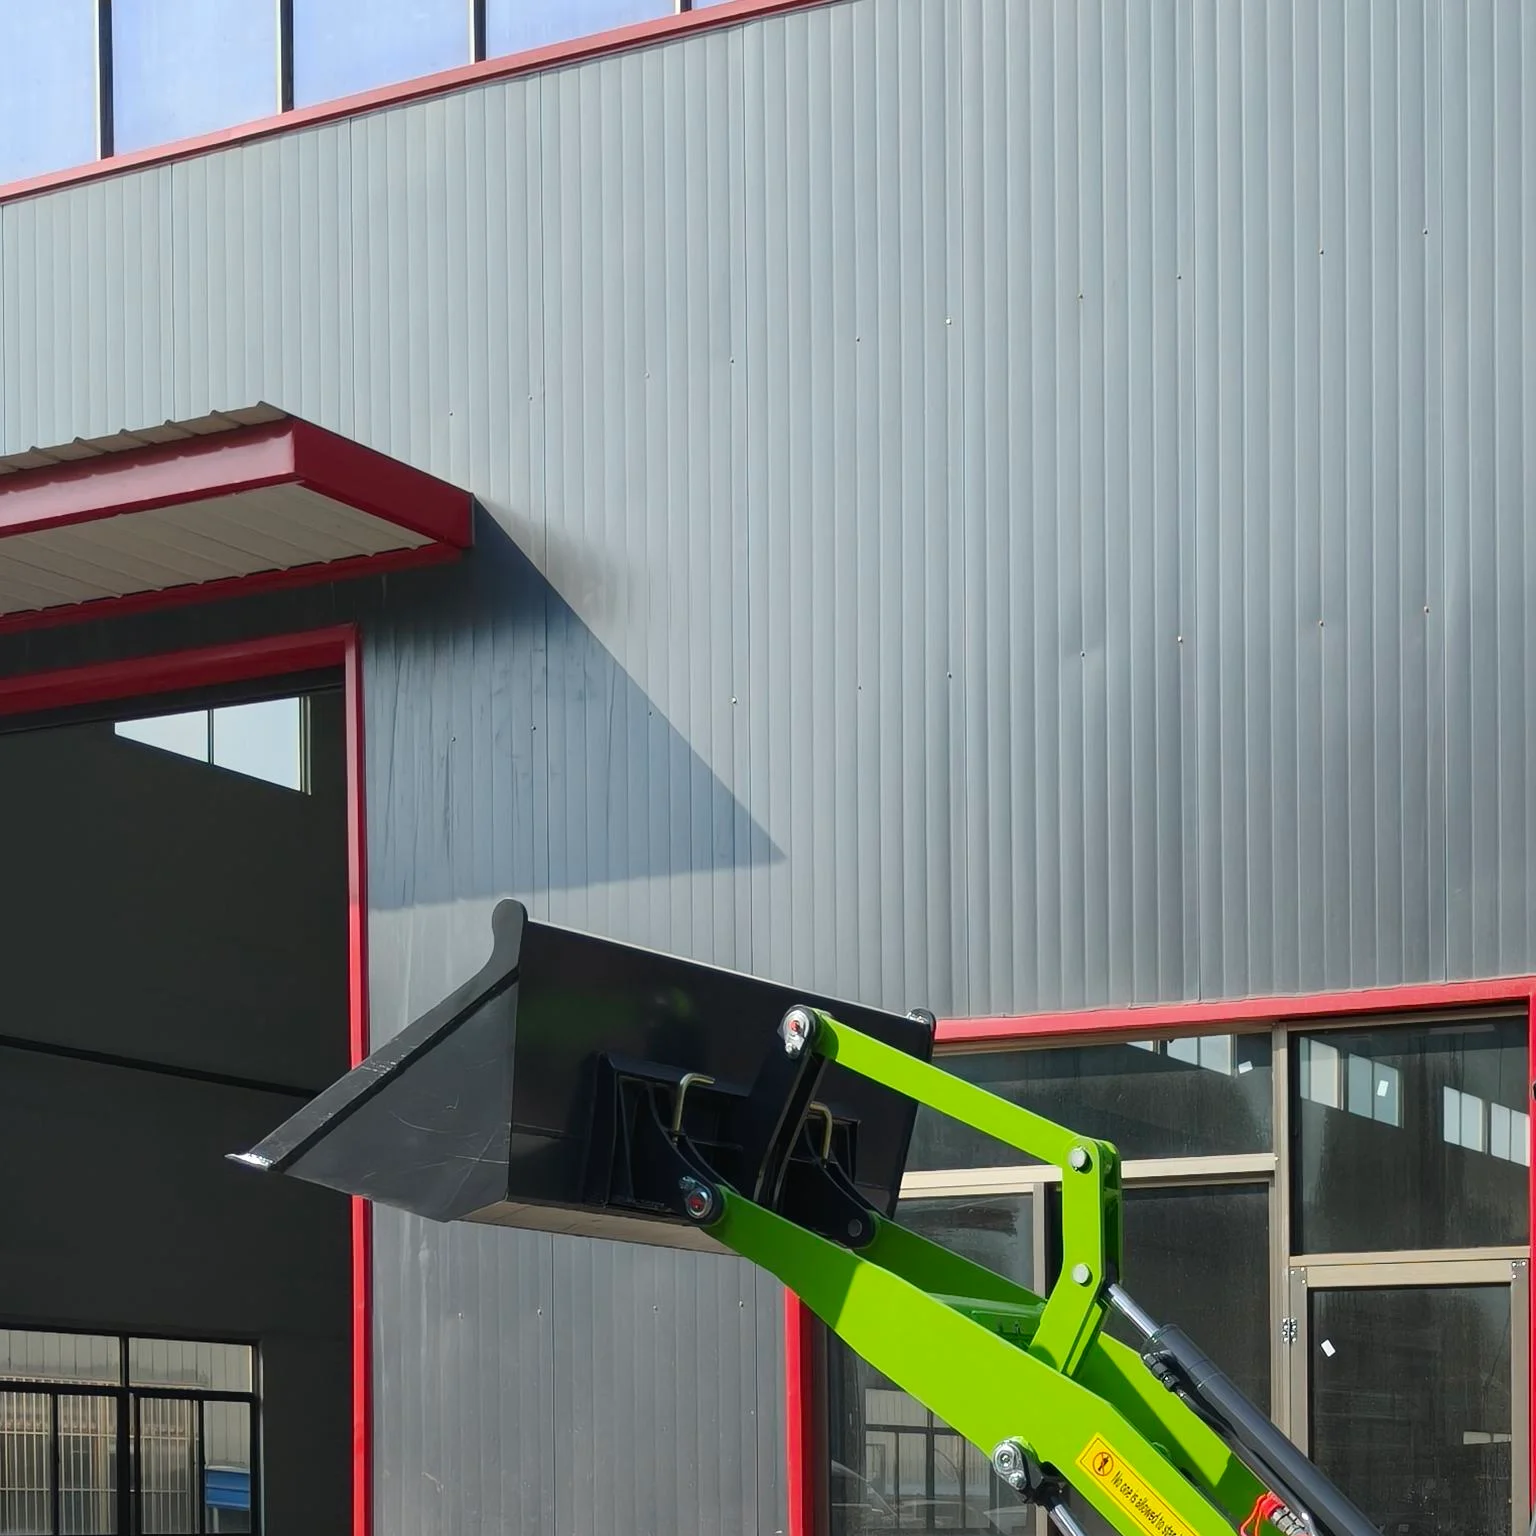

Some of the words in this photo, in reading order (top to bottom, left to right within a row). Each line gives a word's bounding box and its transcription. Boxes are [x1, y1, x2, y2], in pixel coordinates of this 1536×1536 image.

[1111, 1471, 1122, 1487] No
[1120, 1483, 1133, 1498] one
[1135, 1497, 1161, 1528] allowed
